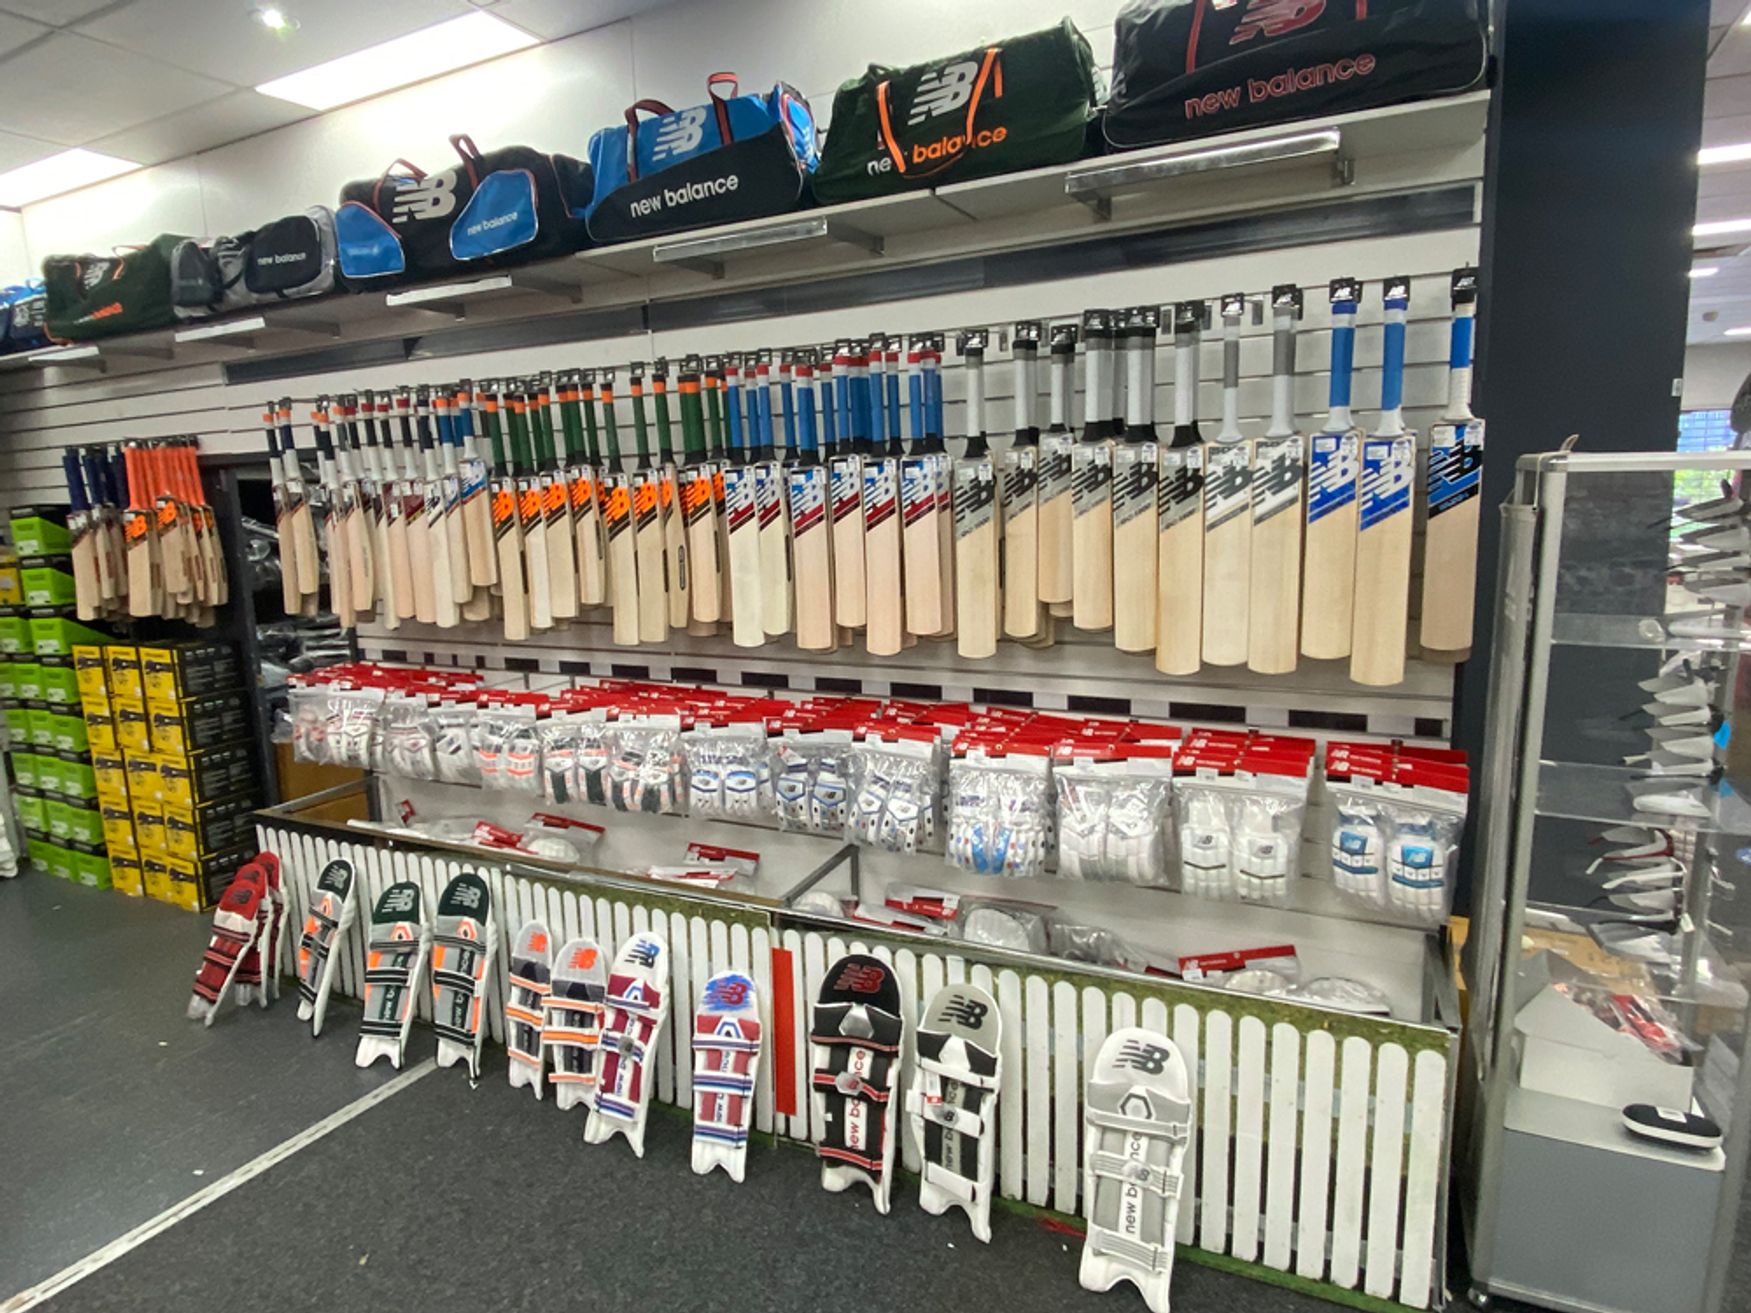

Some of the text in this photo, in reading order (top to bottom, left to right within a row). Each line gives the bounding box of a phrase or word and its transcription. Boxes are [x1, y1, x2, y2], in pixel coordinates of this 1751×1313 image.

[1185, 53, 1376, 119] new balance
[912, 126, 1008, 163] balace
[629, 172, 739, 219] new balance
[467, 211, 518, 236] new balance
[256, 251, 306, 267] new balance
[1112, 1039, 1171, 1075] NB
[1125, 1201, 1137, 1235] new
